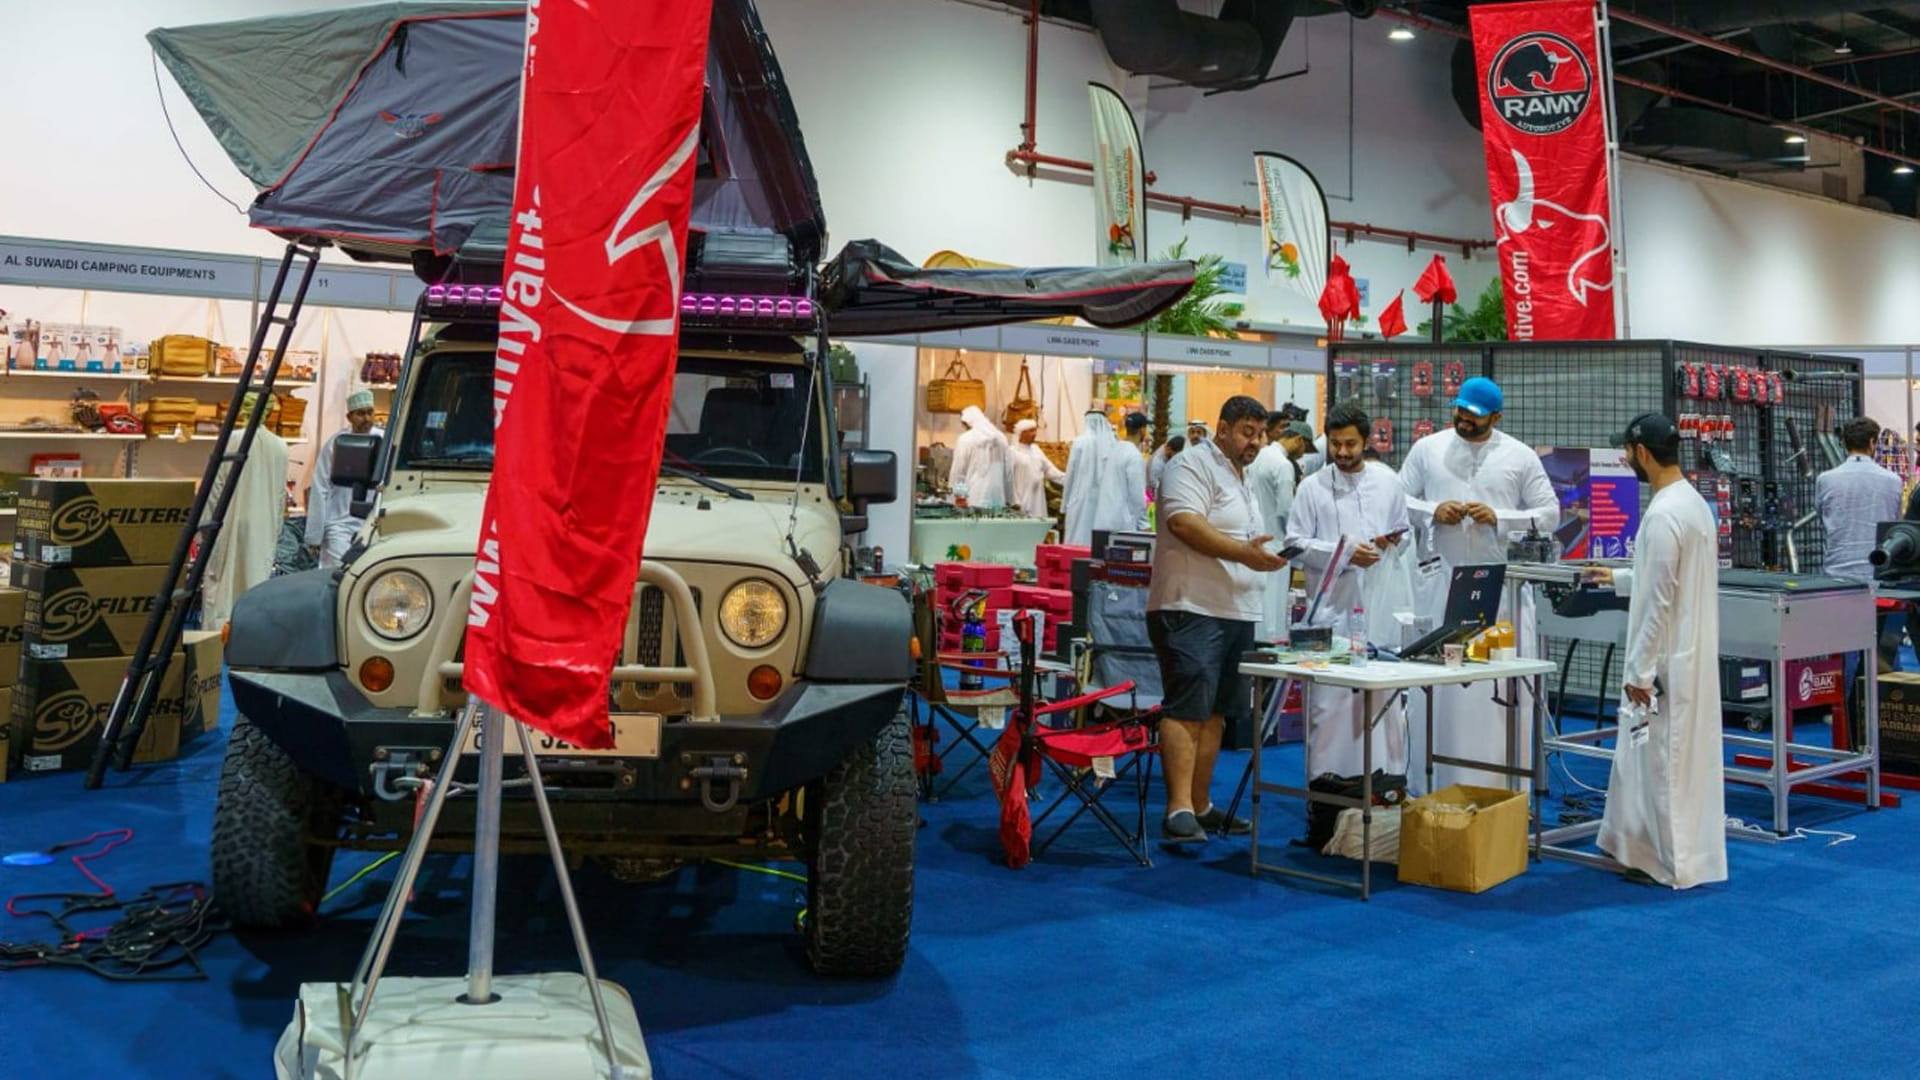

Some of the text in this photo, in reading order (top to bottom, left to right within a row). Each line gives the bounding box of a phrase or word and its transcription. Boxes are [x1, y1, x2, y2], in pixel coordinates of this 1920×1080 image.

[1503, 94, 1585, 118] RAMY
[4, 255, 216, 280] AL SUWAIDI CAMPING EQUIPMENTS
[318, 278, 329, 288] 11
